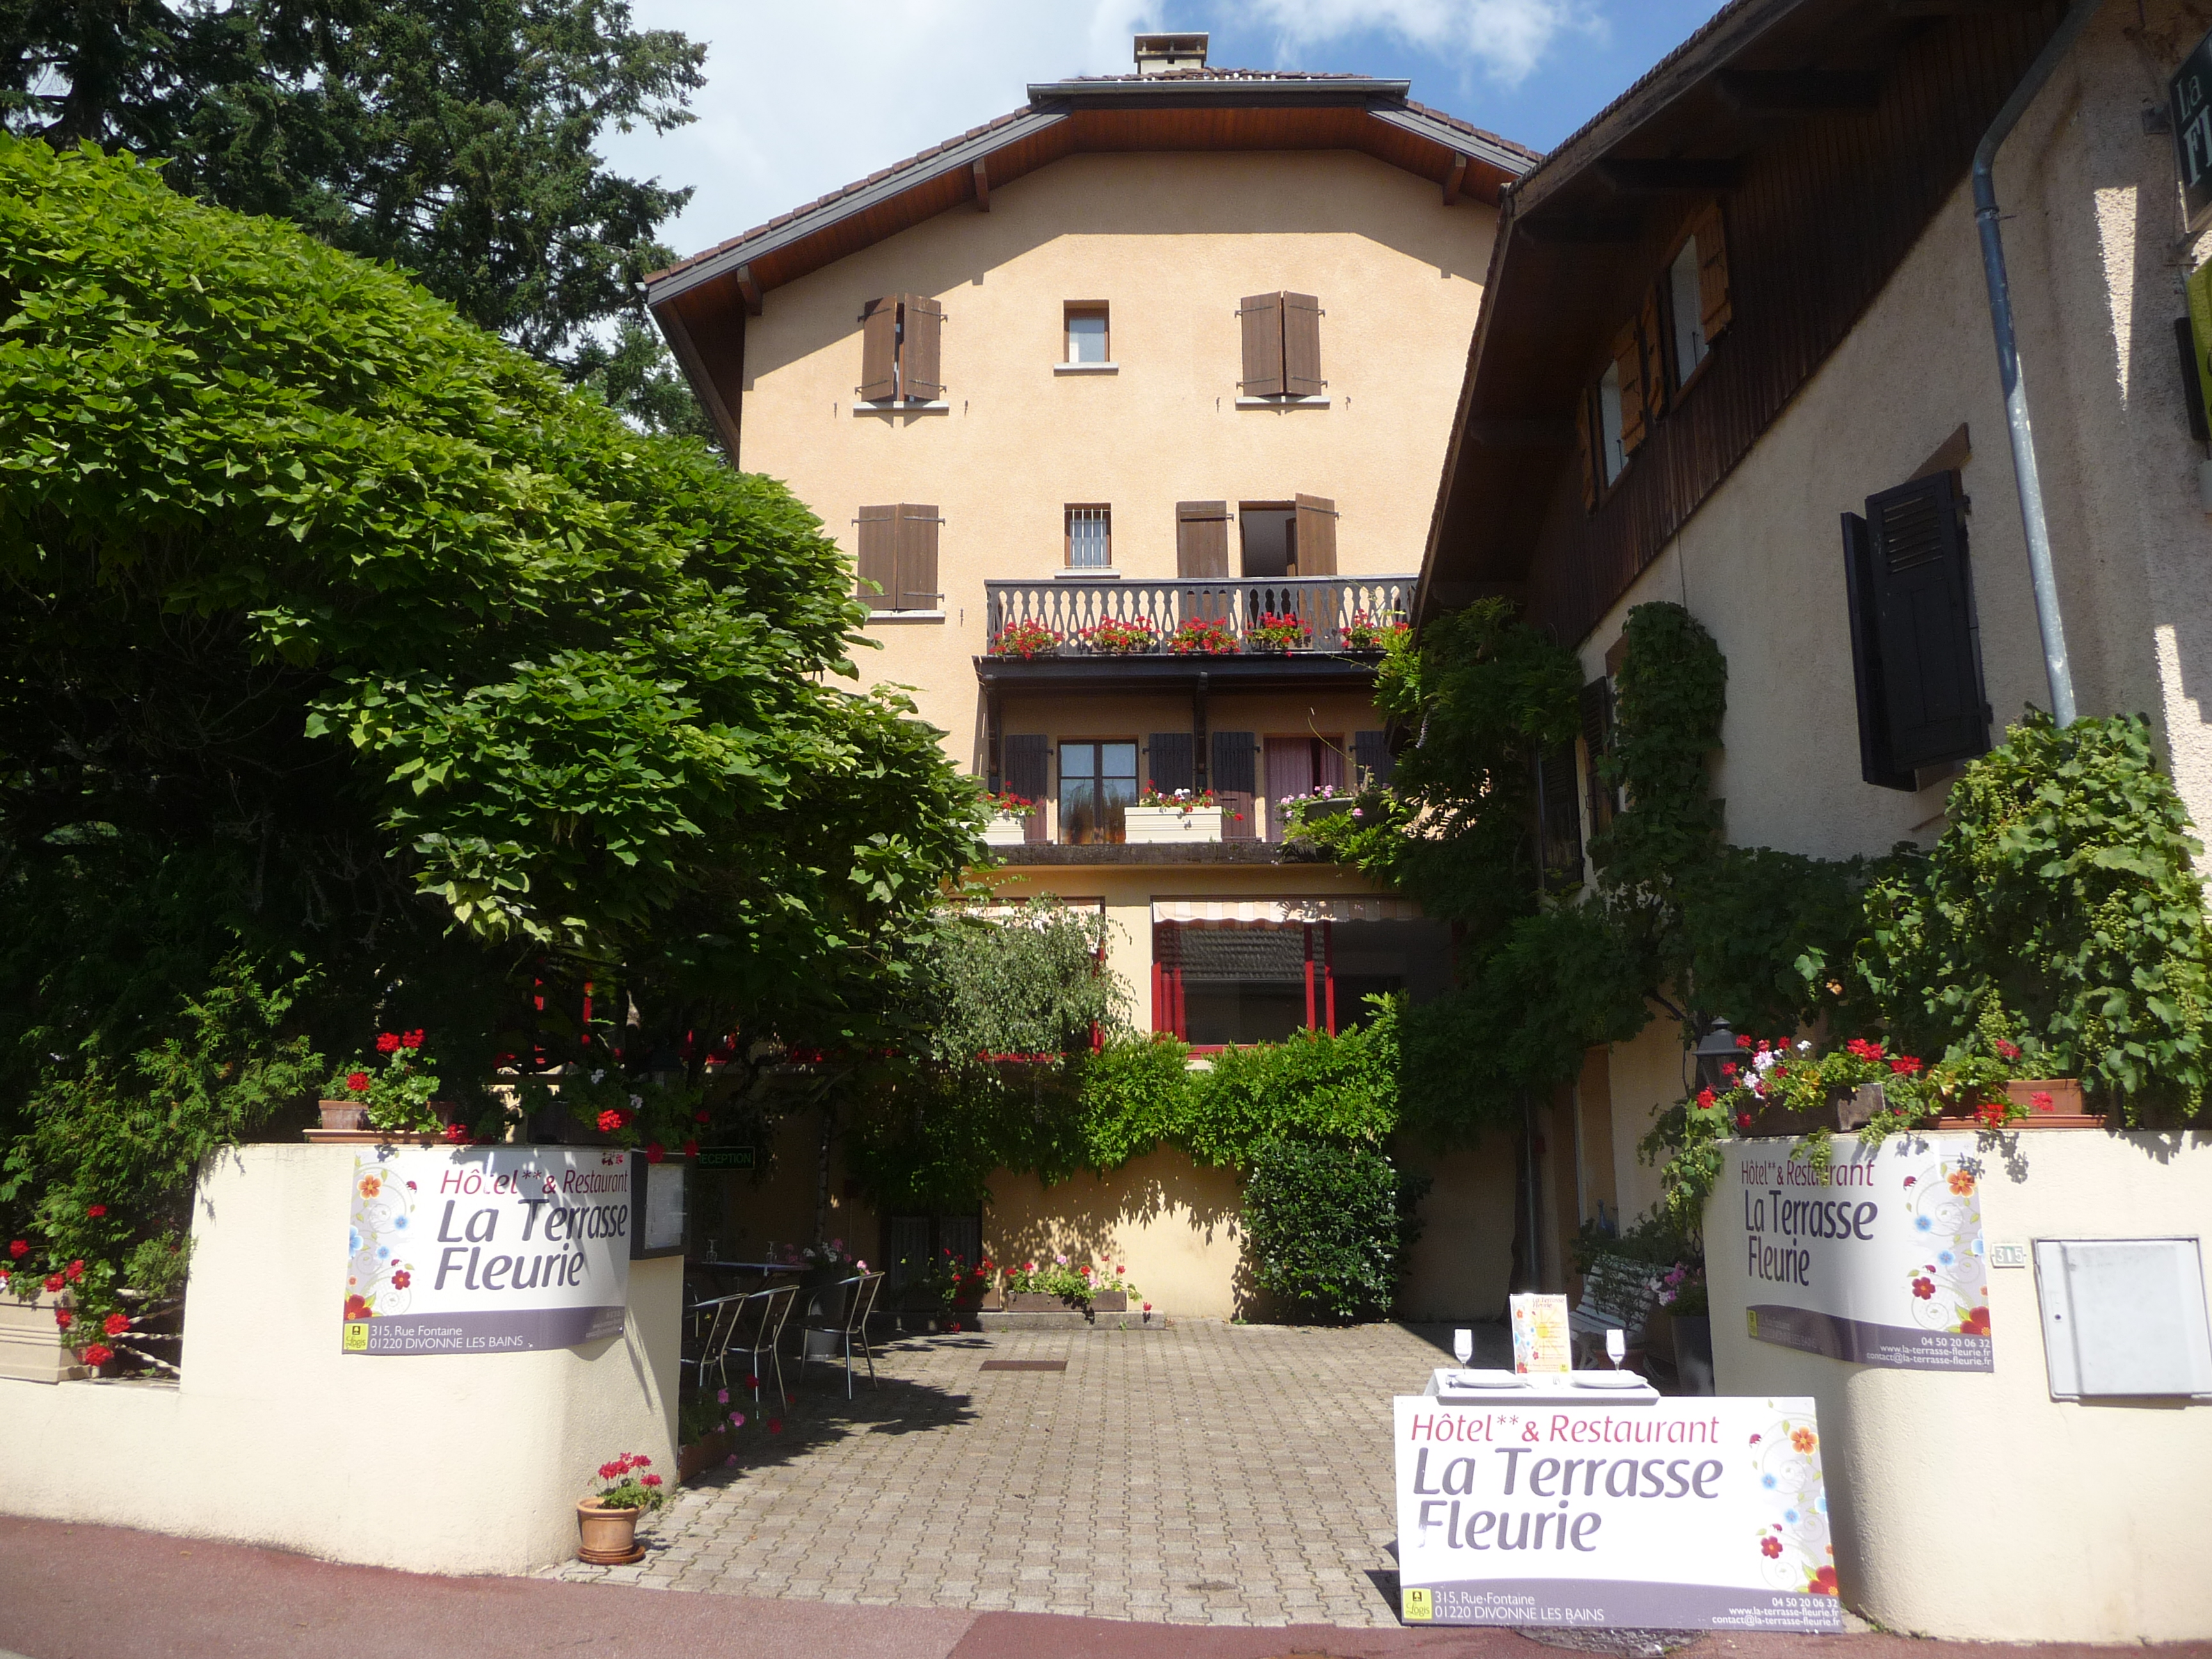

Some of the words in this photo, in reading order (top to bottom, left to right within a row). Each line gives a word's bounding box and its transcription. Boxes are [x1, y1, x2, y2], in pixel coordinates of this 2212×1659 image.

[2176, 76, 2202, 124] La
[542, 1175, 556, 1194] &
[563, 1169, 629, 1194] Restaurant
[1777, 1166, 1784, 1185] &
[437, 1199, 499, 1242] La
[517, 1198, 628, 1241] Terrasse
[1745, 1189, 1765, 1232] La
[1768, 1190, 1878, 1240] Terrasse
[1749, 1235, 1810, 1286] Fleurie
[1996, 1248, 2023, 1262] 315
[434, 1242, 584, 1290] Fleurie
[371, 1326, 392, 1337] 315,
[394, 1326, 415, 1336] Rue
[418, 1326, 463, 1336] Fontaine
[370, 1338, 403, 1349] 01220
[406, 1338, 463, 1349] DIVONNE
[466, 1337, 485, 1348] LES
[489, 1335, 523, 1347] BAINS
[1921, 1337, 1933, 1346] 04
[1936, 1338, 1947, 1346] 50
[1950, 1338, 1962, 1347] 20
[1964, 1338, 1976, 1347] 06
[1980, 1339, 1991, 1347] 32
[1880, 1345, 1991, 1356] www.la-terrasse-fleurie.fr
[1866, 1352, 1992, 1365] contact@la-terrasse-fleurie.fr
[1521, 1421, 1539, 1442] &
[1550, 1415, 1720, 1443] Restaurant
[1413, 1447, 1475, 1495] La
[1495, 1448, 1723, 1498] Terrasse
[1416, 1500, 1601, 1551] Fleurie
[1435, 1591, 1458, 1605] 315,
[1461, 1592, 1484, 1604] Rue
[1487, 1592, 1535, 1605] Fontaine
[1772, 1598, 1783, 1607] 04
[1786, 1598, 1797, 1607] 50
[1800, 1598, 1811, 1607] 20
[1813, 1598, 1824, 1607] 06
[1827, 1599, 1838, 1608] 32
[1406, 1603, 1430, 1617] Logis
[1435, 1605, 1471, 1618] 01220
[1475, 1606, 1537, 1620] DIVONNE
[1541, 1607, 1562, 1620] LES
[1566, 1608, 1605, 1621] BAINS
[1729, 1606, 1839, 1617] www.la-terrasse-fleurie.fr
[1712, 1615, 1840, 1626] contact@la-terrasse-fleurie.fr
